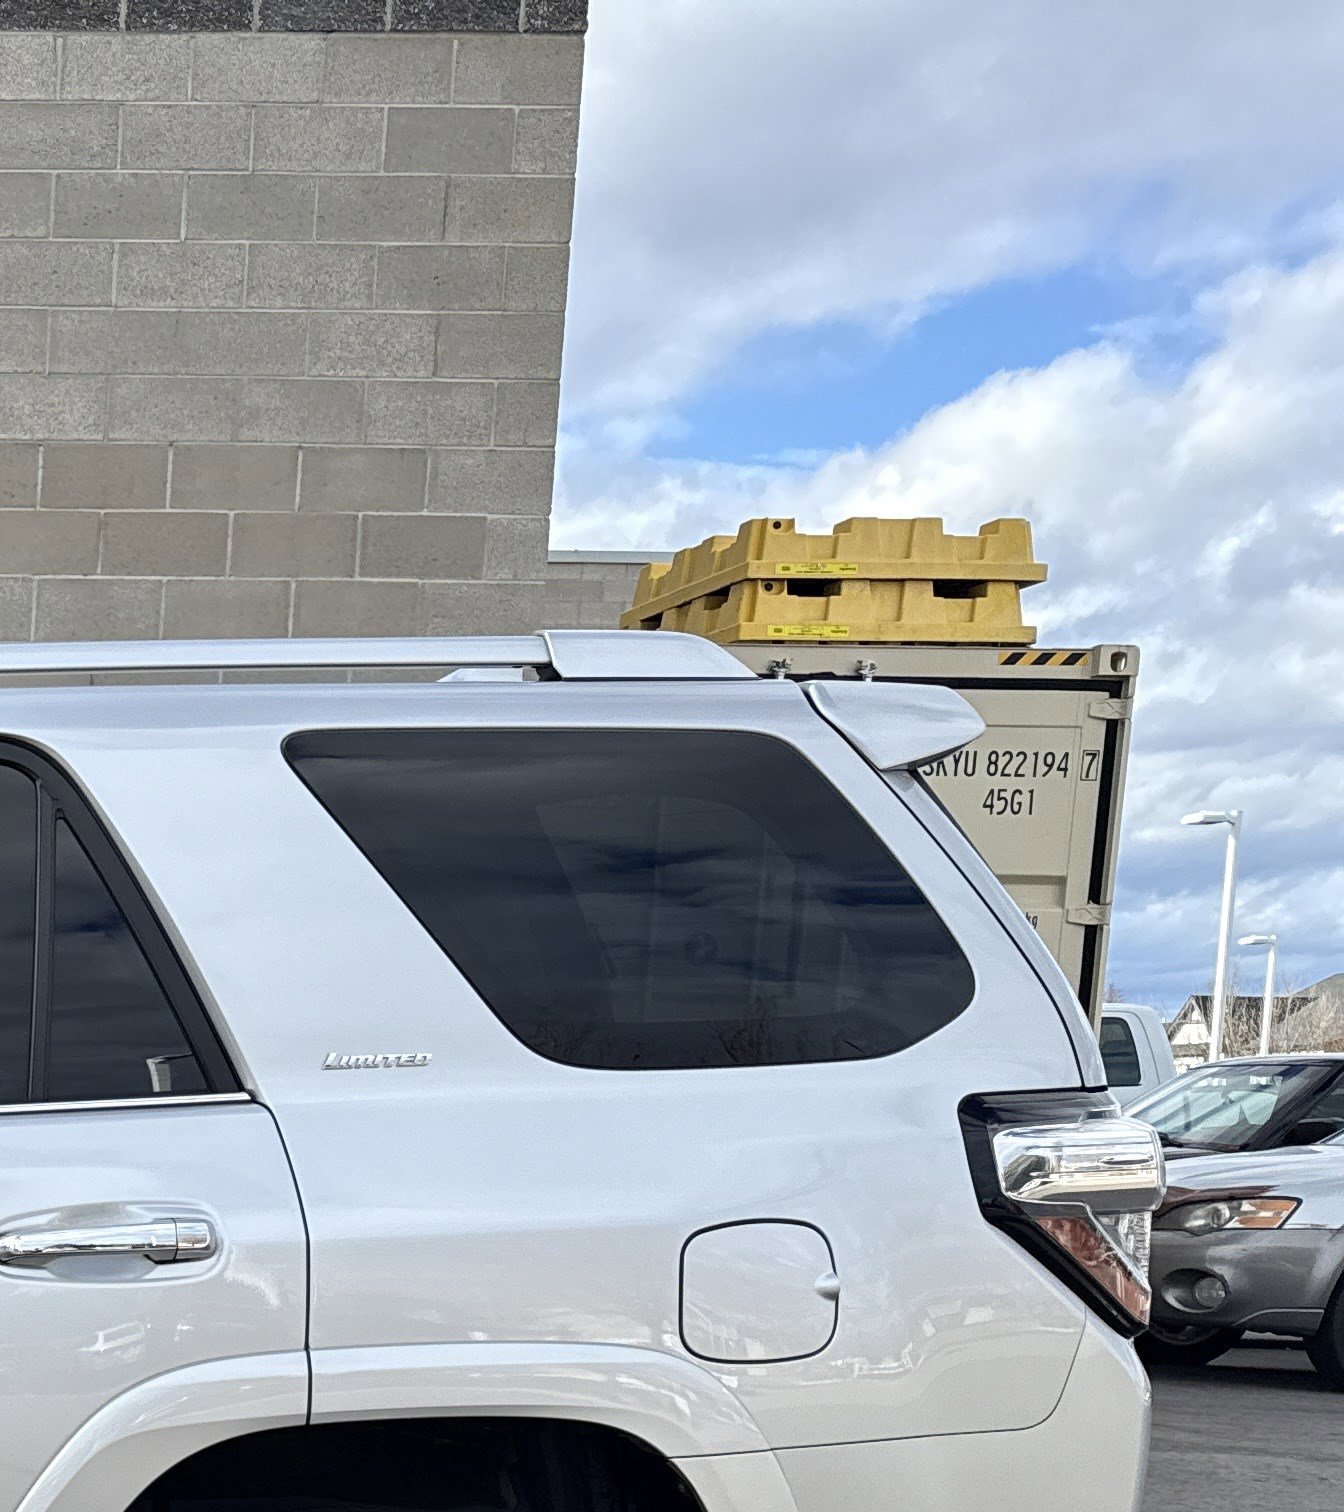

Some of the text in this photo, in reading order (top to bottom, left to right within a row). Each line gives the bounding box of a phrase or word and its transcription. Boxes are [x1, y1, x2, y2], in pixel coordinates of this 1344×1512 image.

[986, 750, 1069, 778] 822194
[1083, 752, 1098, 778] 7
[982, 788, 1035, 816] 45G1
